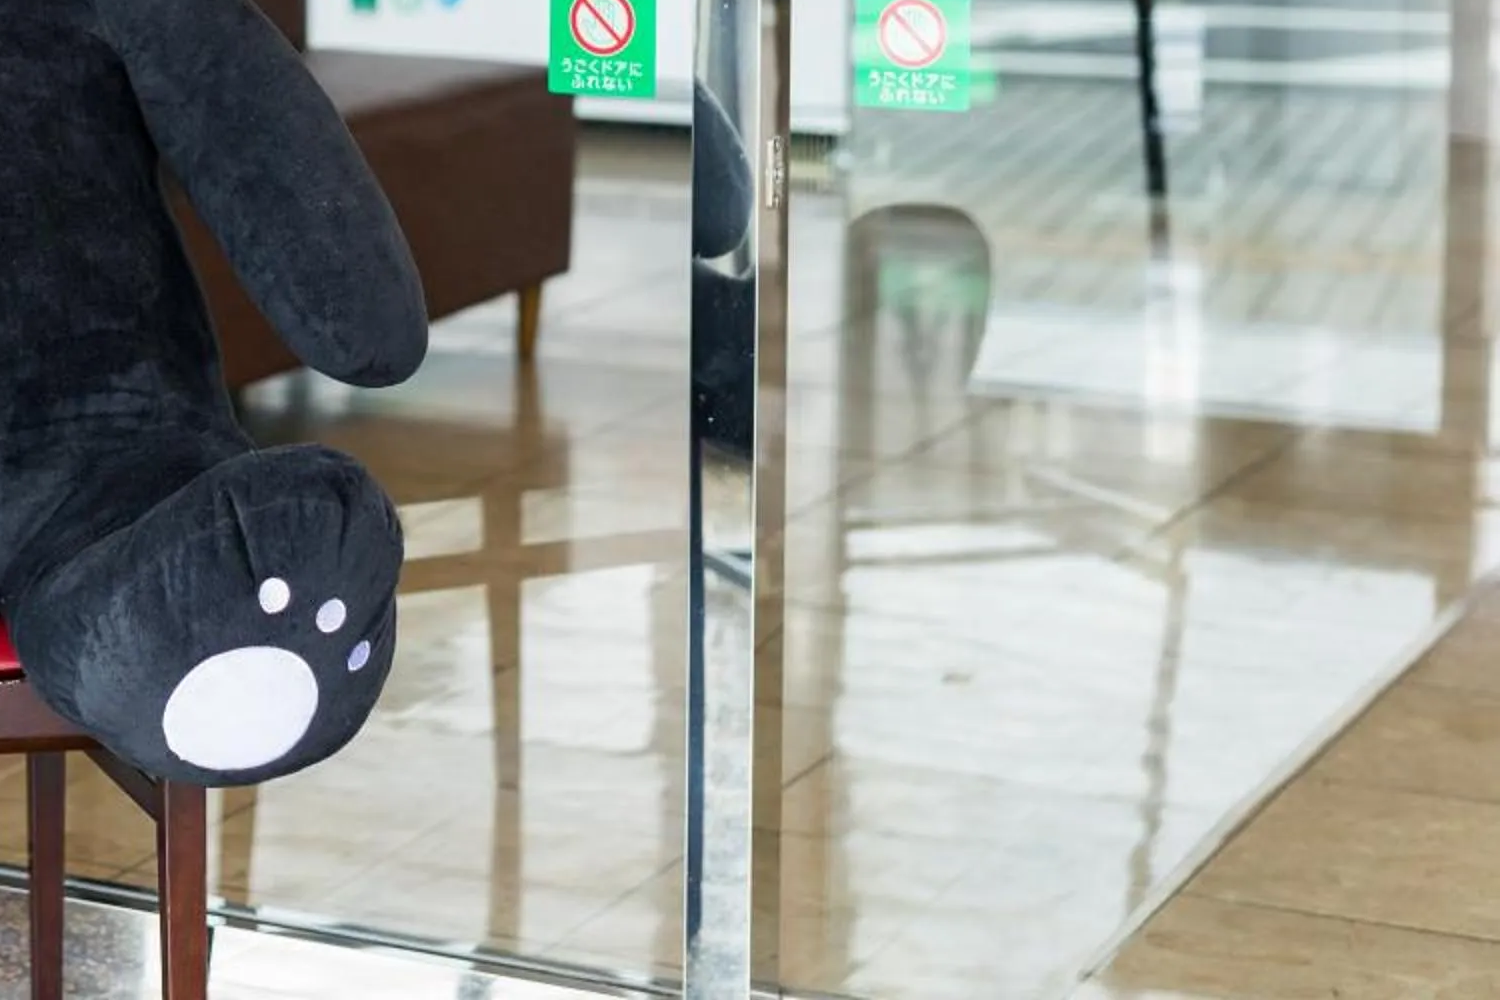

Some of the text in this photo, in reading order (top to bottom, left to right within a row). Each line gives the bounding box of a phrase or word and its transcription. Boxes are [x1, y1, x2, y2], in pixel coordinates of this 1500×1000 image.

[560, 57, 644, 77] うごくドアに
[571, 74, 634, 92] ふれない
[867, 69, 957, 90] うごくドアに
[878, 87, 946, 105] ふれない
